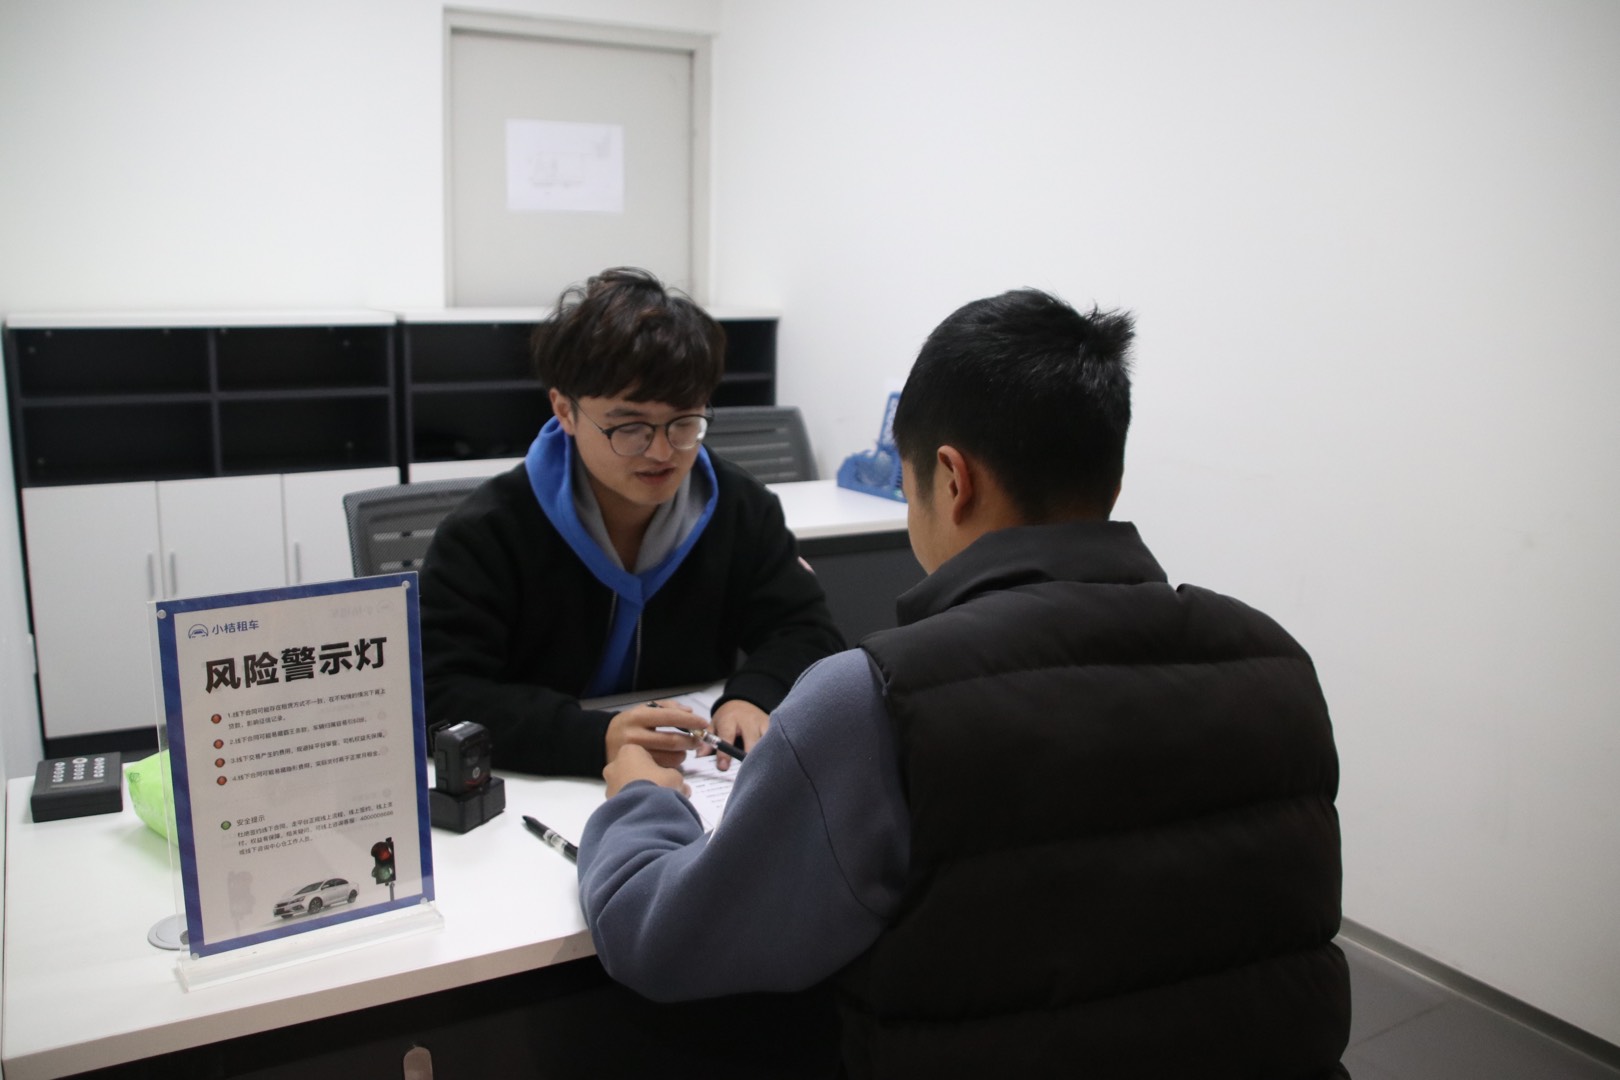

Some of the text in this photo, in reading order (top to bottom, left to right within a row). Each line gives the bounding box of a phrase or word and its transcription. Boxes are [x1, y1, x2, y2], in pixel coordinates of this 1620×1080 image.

[212, 620, 259, 635] 小桔租车
[206, 636, 387, 693] 风险警示灯
[236, 815, 265, 827] 安全提示
